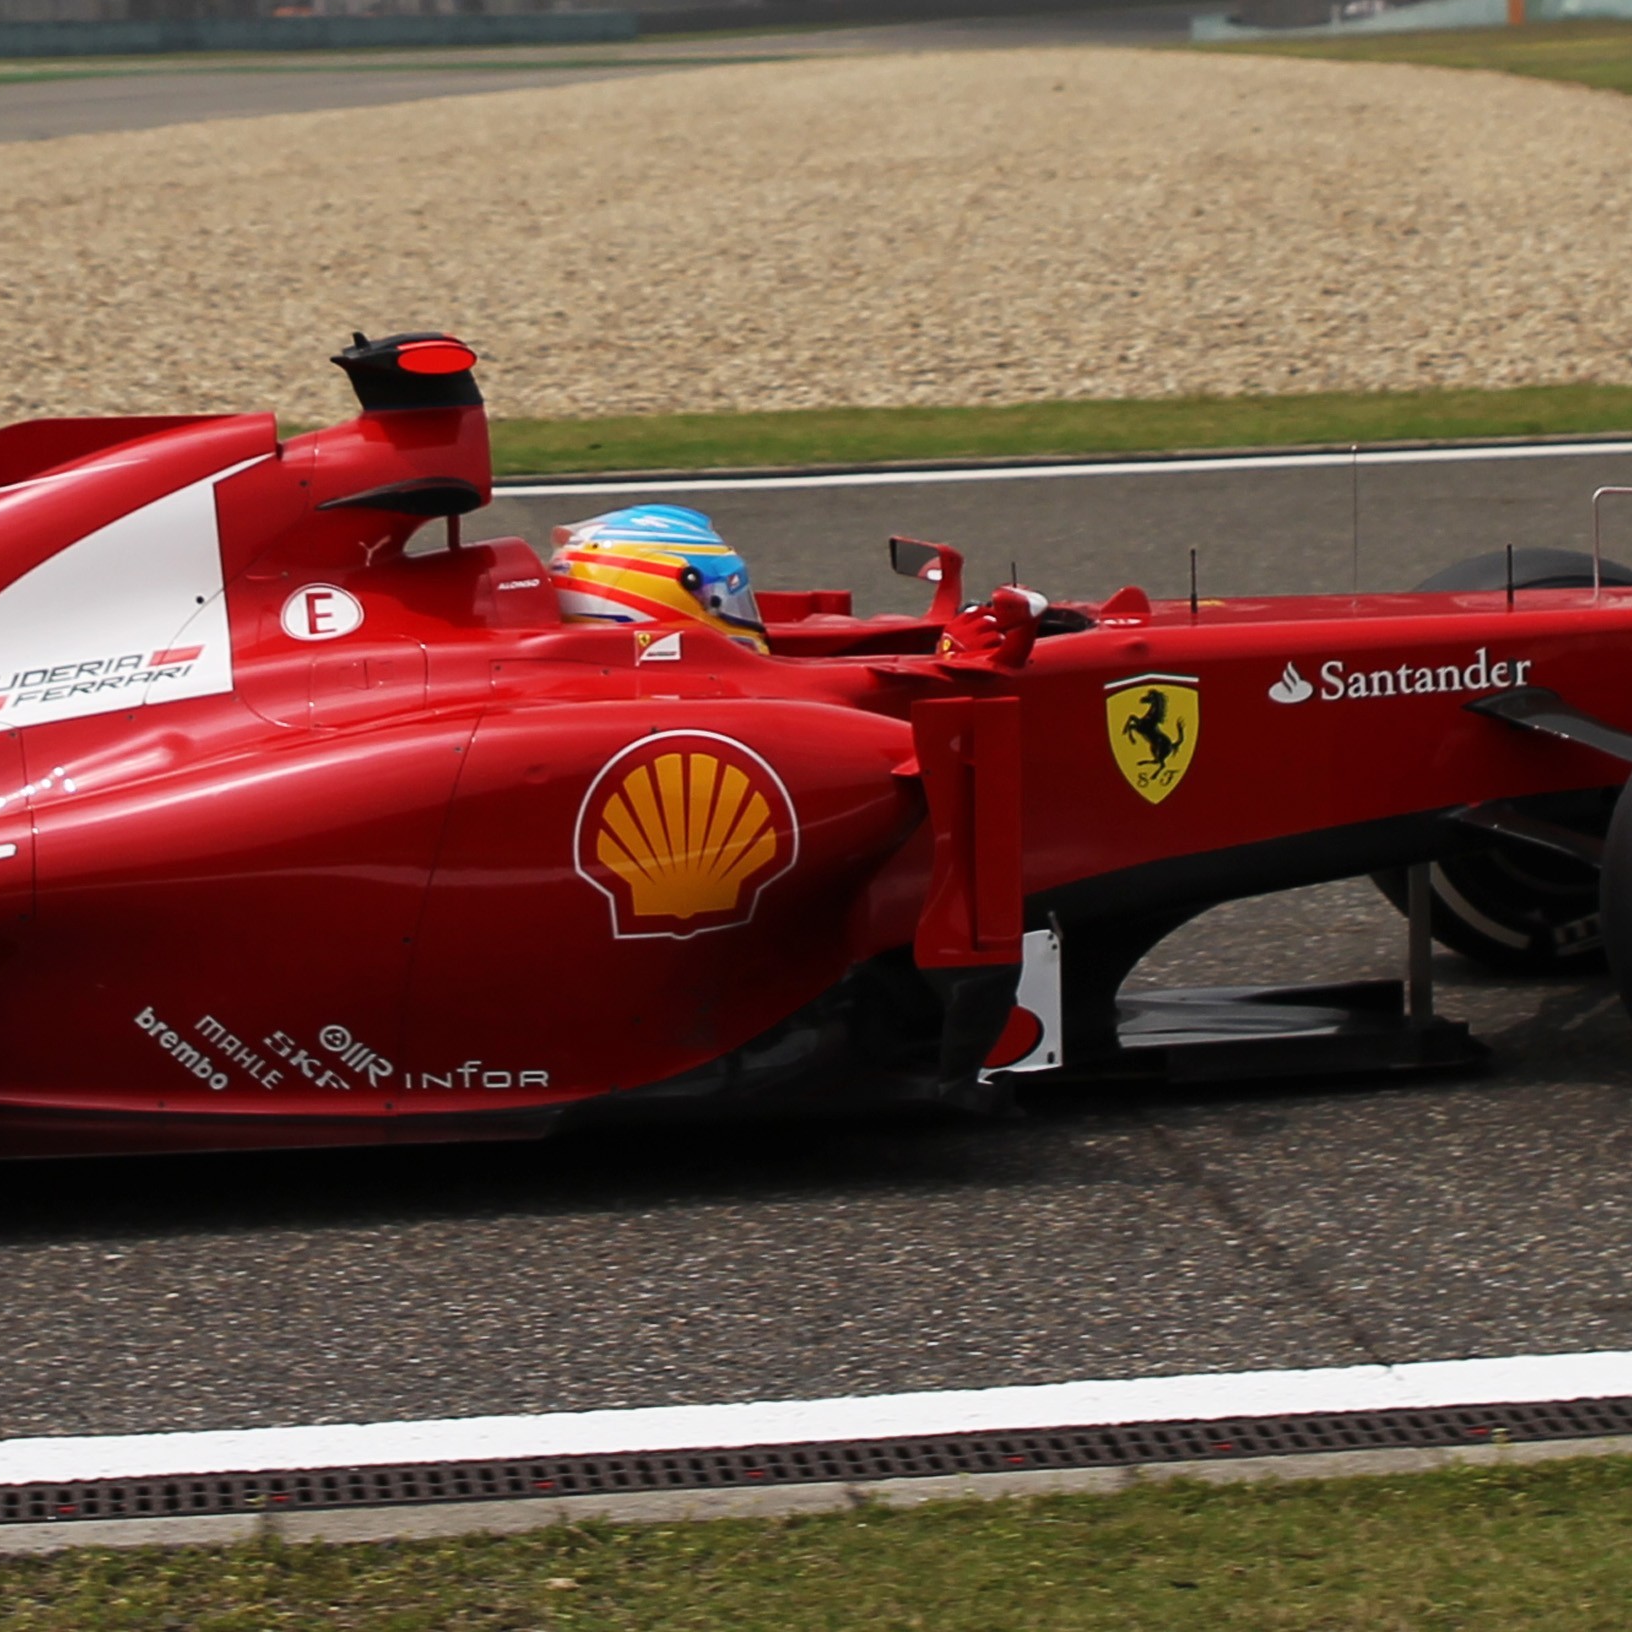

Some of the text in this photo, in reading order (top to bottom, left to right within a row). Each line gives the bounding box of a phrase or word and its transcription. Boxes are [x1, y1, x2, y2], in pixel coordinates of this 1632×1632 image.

[306, 591, 337, 635] E
[12, 664, 194, 708] FERRARI
[1320, 646, 1532, 701] Santander
[134, 1006, 229, 1091] brembo
[194, 1014, 284, 1090] MAHLE
[263, 1030, 351, 1090] SKF
